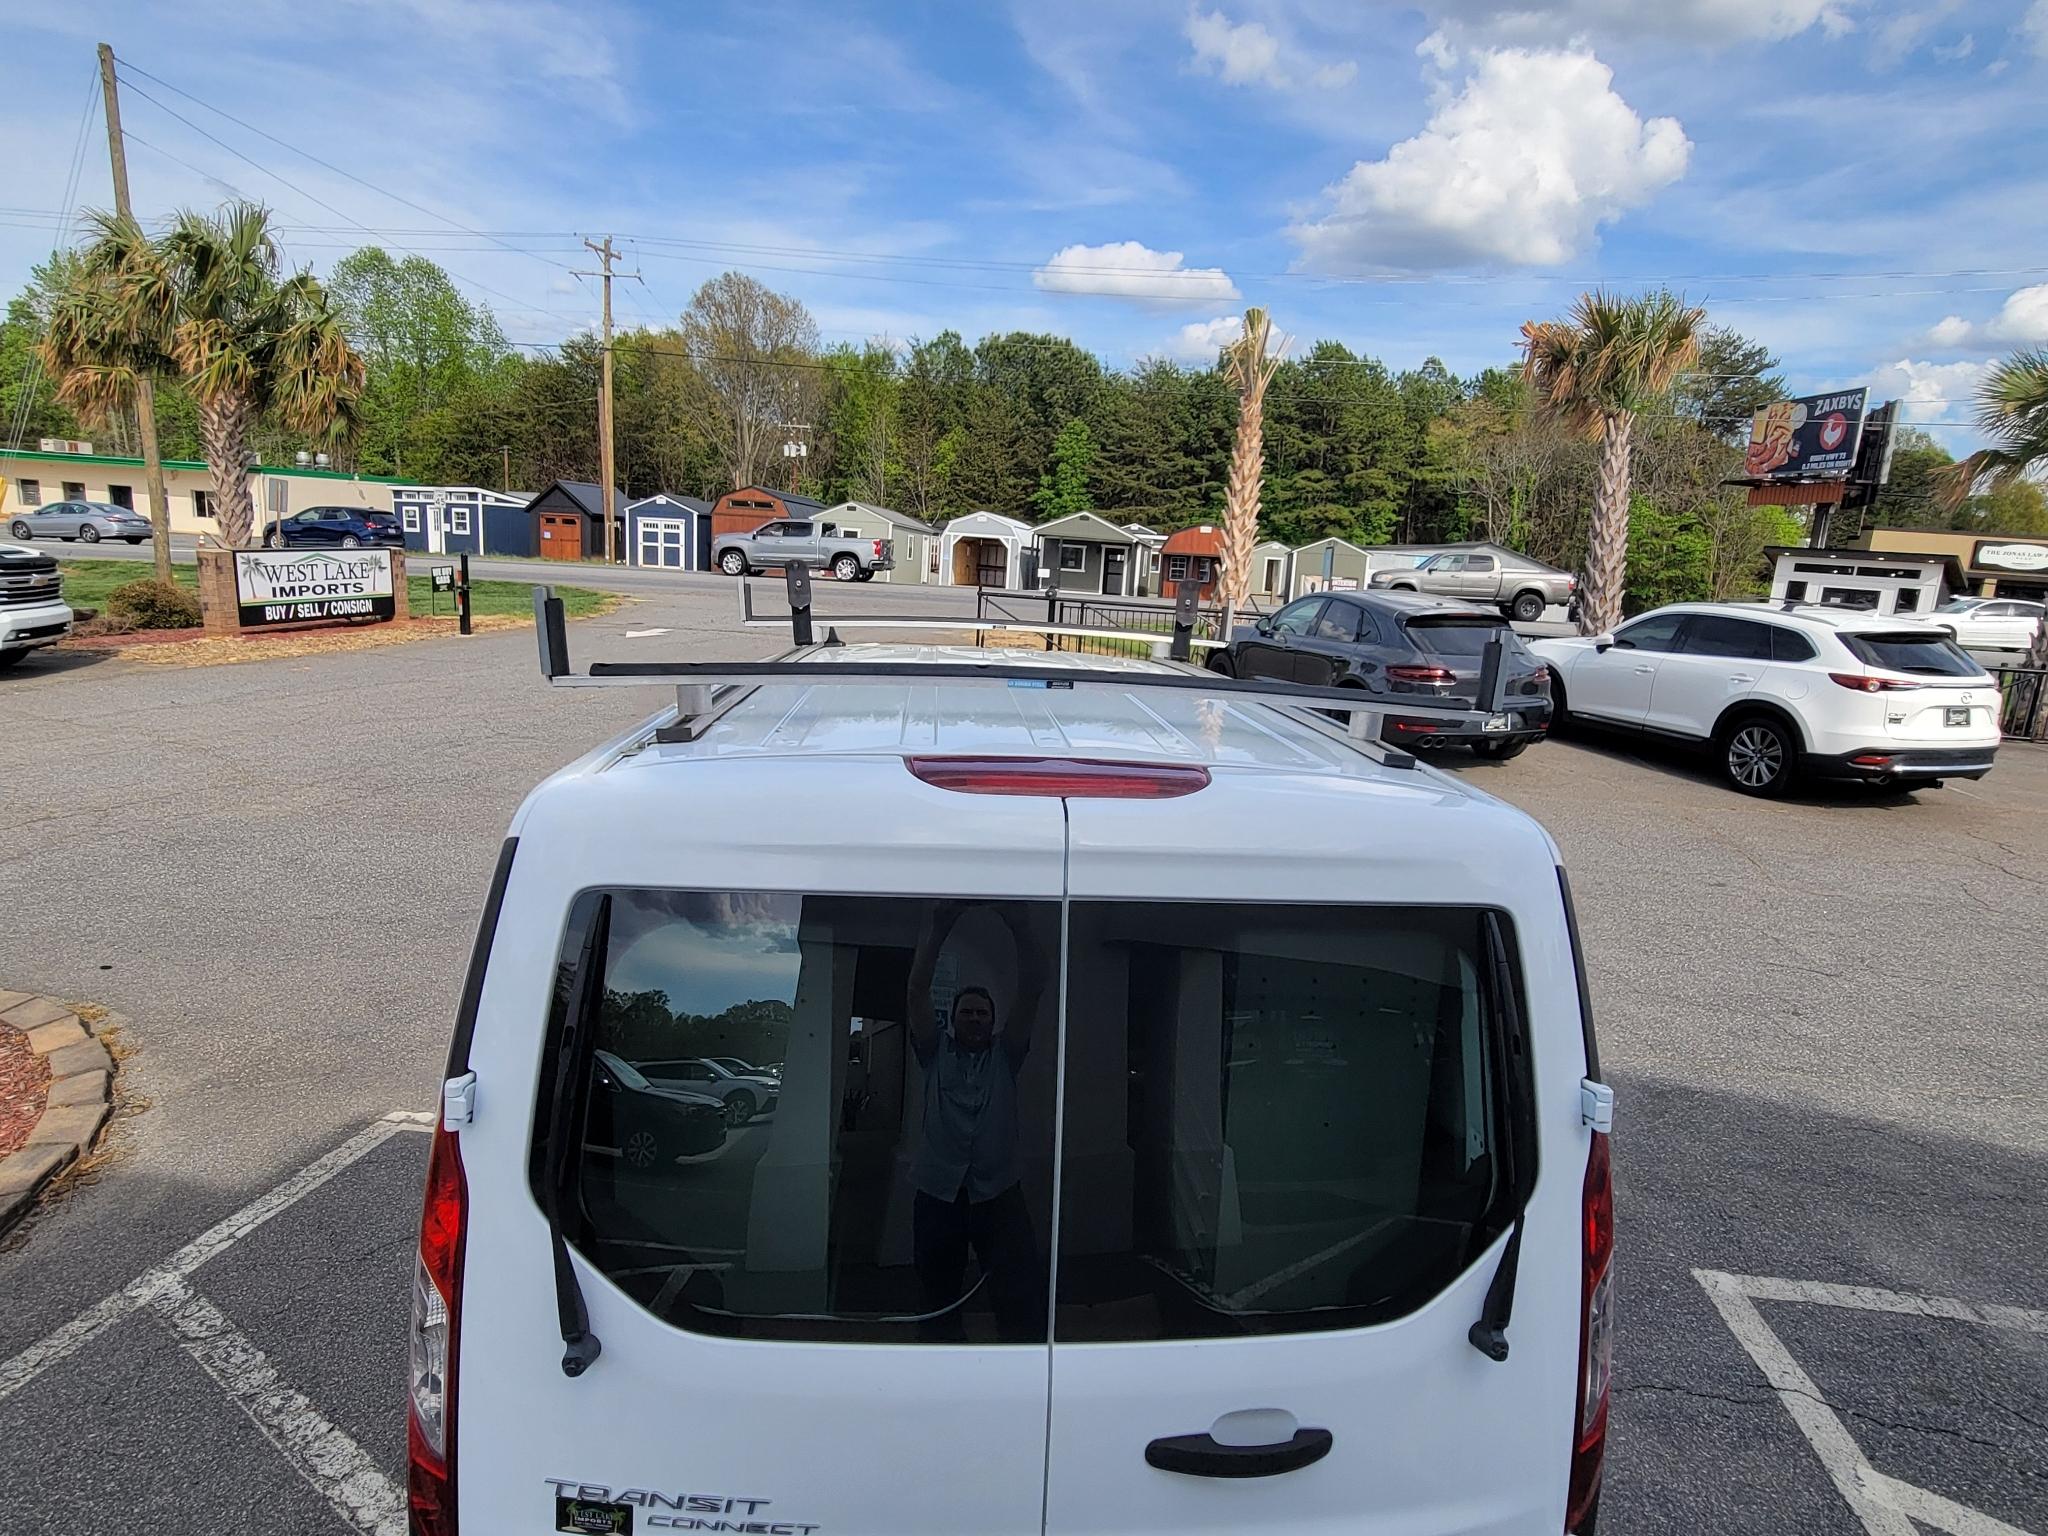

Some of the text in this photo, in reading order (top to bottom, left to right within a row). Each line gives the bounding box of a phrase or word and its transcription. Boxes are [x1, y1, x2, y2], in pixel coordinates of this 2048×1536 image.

[1814, 393, 1862, 416] ZAXBYS
[1809, 454, 1826, 462] RIGHT
[1826, 453, 1839, 461] HWY
[1810, 462, 1826, 470] MILES
[1834, 460, 1852, 468] RIGHT
[435, 497, 445, 506] 45
[263, 562, 370, 583] WEST LAKE
[442, 567, 452, 576] BUY
[436, 575, 451, 585] CARS
[271, 582, 364, 598] IMPORTS
[265, 599, 373, 621] BUY / SELL / CONSIGN
[544, 1477, 772, 1515] TRANSIT
[574, 1516, 613, 1524] IMPORTS
[647, 1514, 821, 1536] CONNECT
